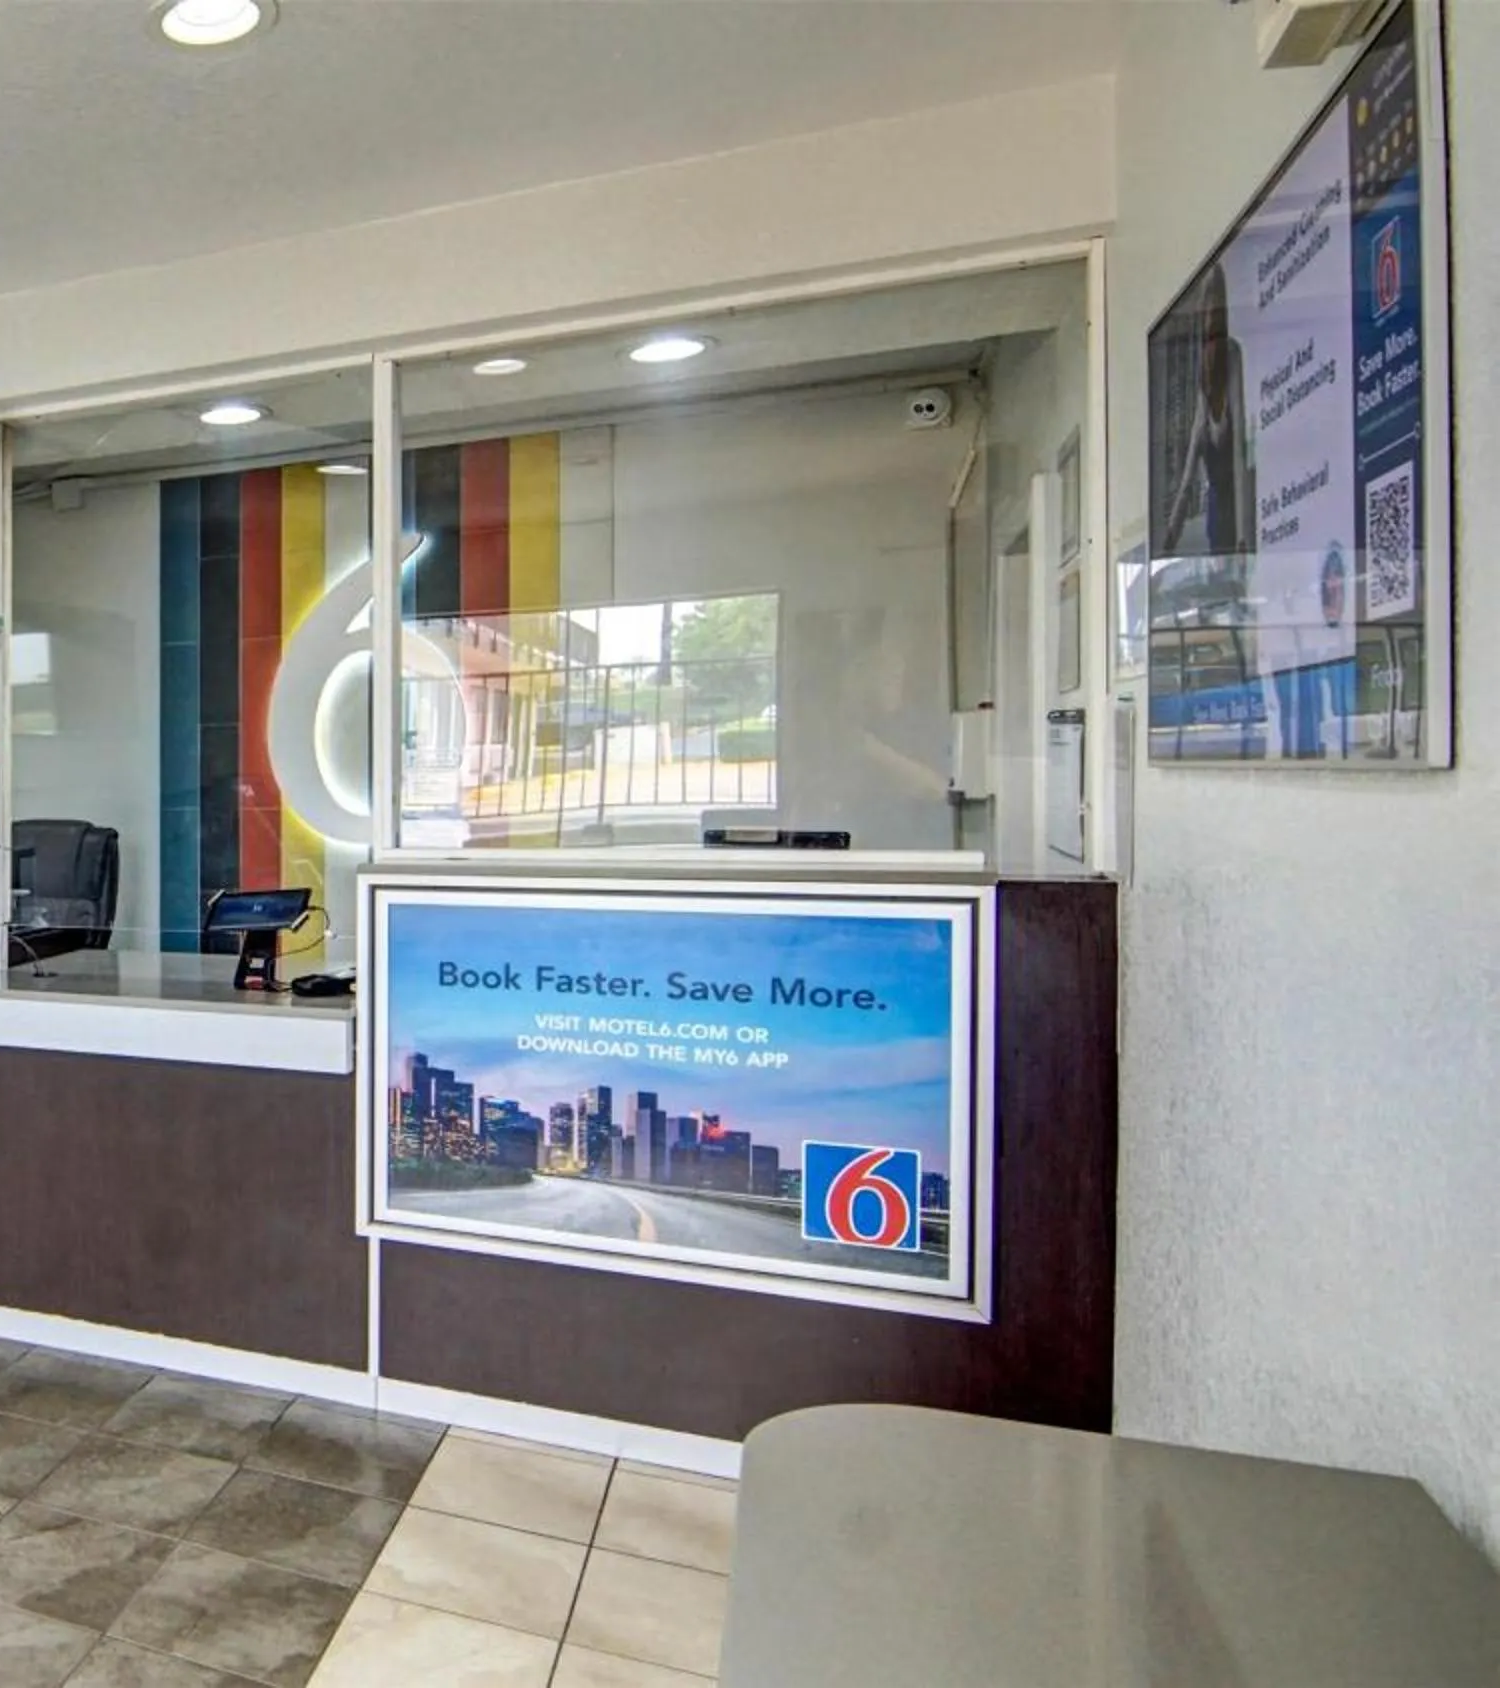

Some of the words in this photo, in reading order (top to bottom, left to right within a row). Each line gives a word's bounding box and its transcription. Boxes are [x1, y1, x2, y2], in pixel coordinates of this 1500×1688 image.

[268, 530, 466, 848] 6
[438, 960, 522, 991] Book
[535, 965, 650, 998] Faster.
[666, 971, 754, 1003] Save
[770, 976, 887, 1011] More.
[517, 1033, 639, 1059] DOWNLOAD
[646, 1042, 686, 1062] THE
[694, 1047, 739, 1067] MY6
[746, 1050, 789, 1070] APP
[534, 1013, 581, 1032] VISIT
[589, 1016, 729, 1042] MOTEL6.COM
[737, 1025, 770, 1045] OR
[825, 1147, 911, 1249] 6
